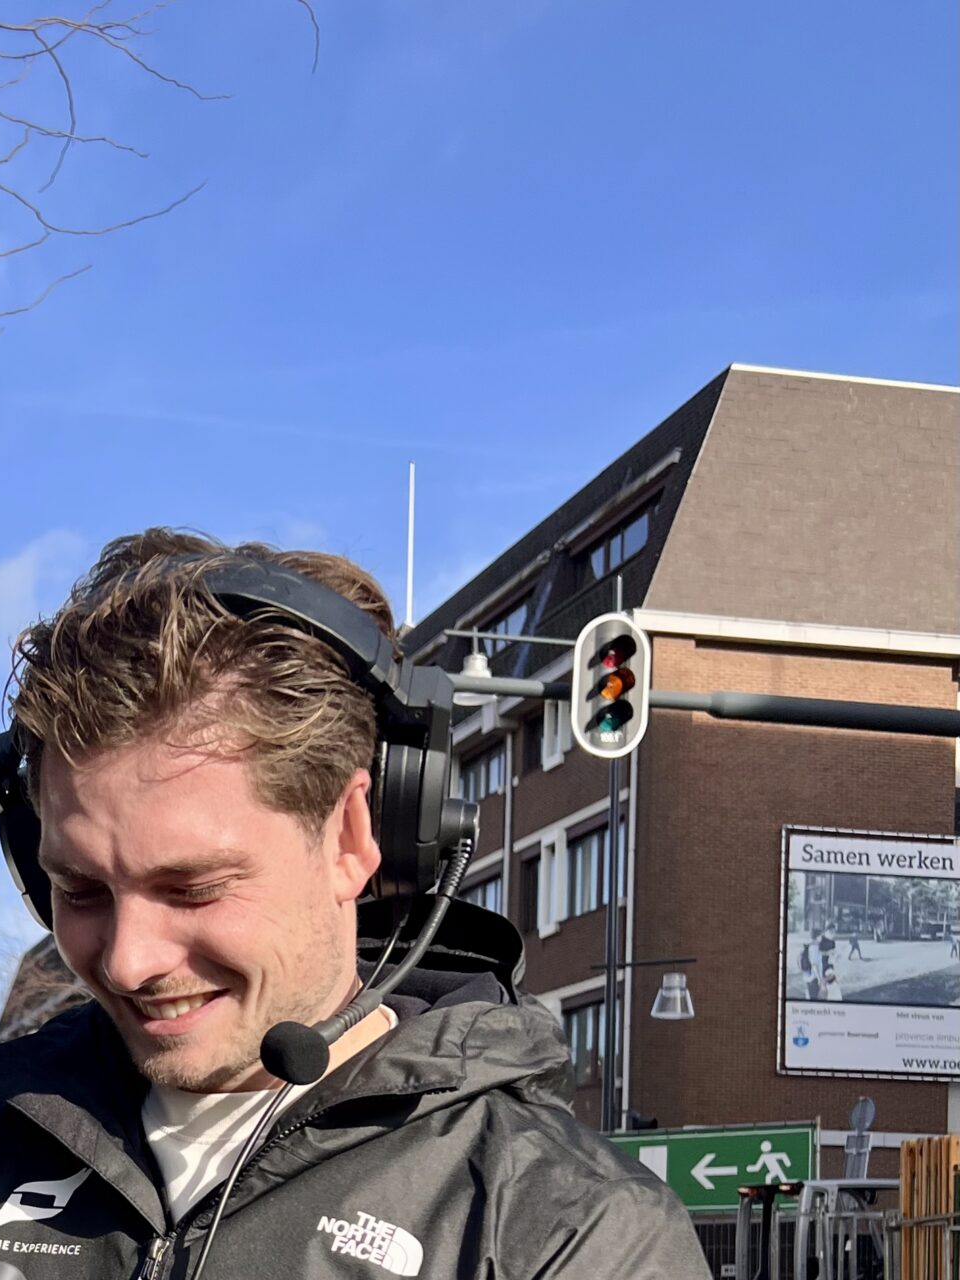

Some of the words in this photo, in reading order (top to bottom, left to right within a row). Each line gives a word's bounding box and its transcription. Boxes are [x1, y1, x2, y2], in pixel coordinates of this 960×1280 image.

[802, 843, 870, 866] Samen
[877, 850, 954, 871] werken
[317, 1216, 392, 1255] NORTH
[357, 1211, 397, 1240] THE
[13, 1241, 81, 1256] EXPERIENCE
[331, 1235, 385, 1266] FACE
